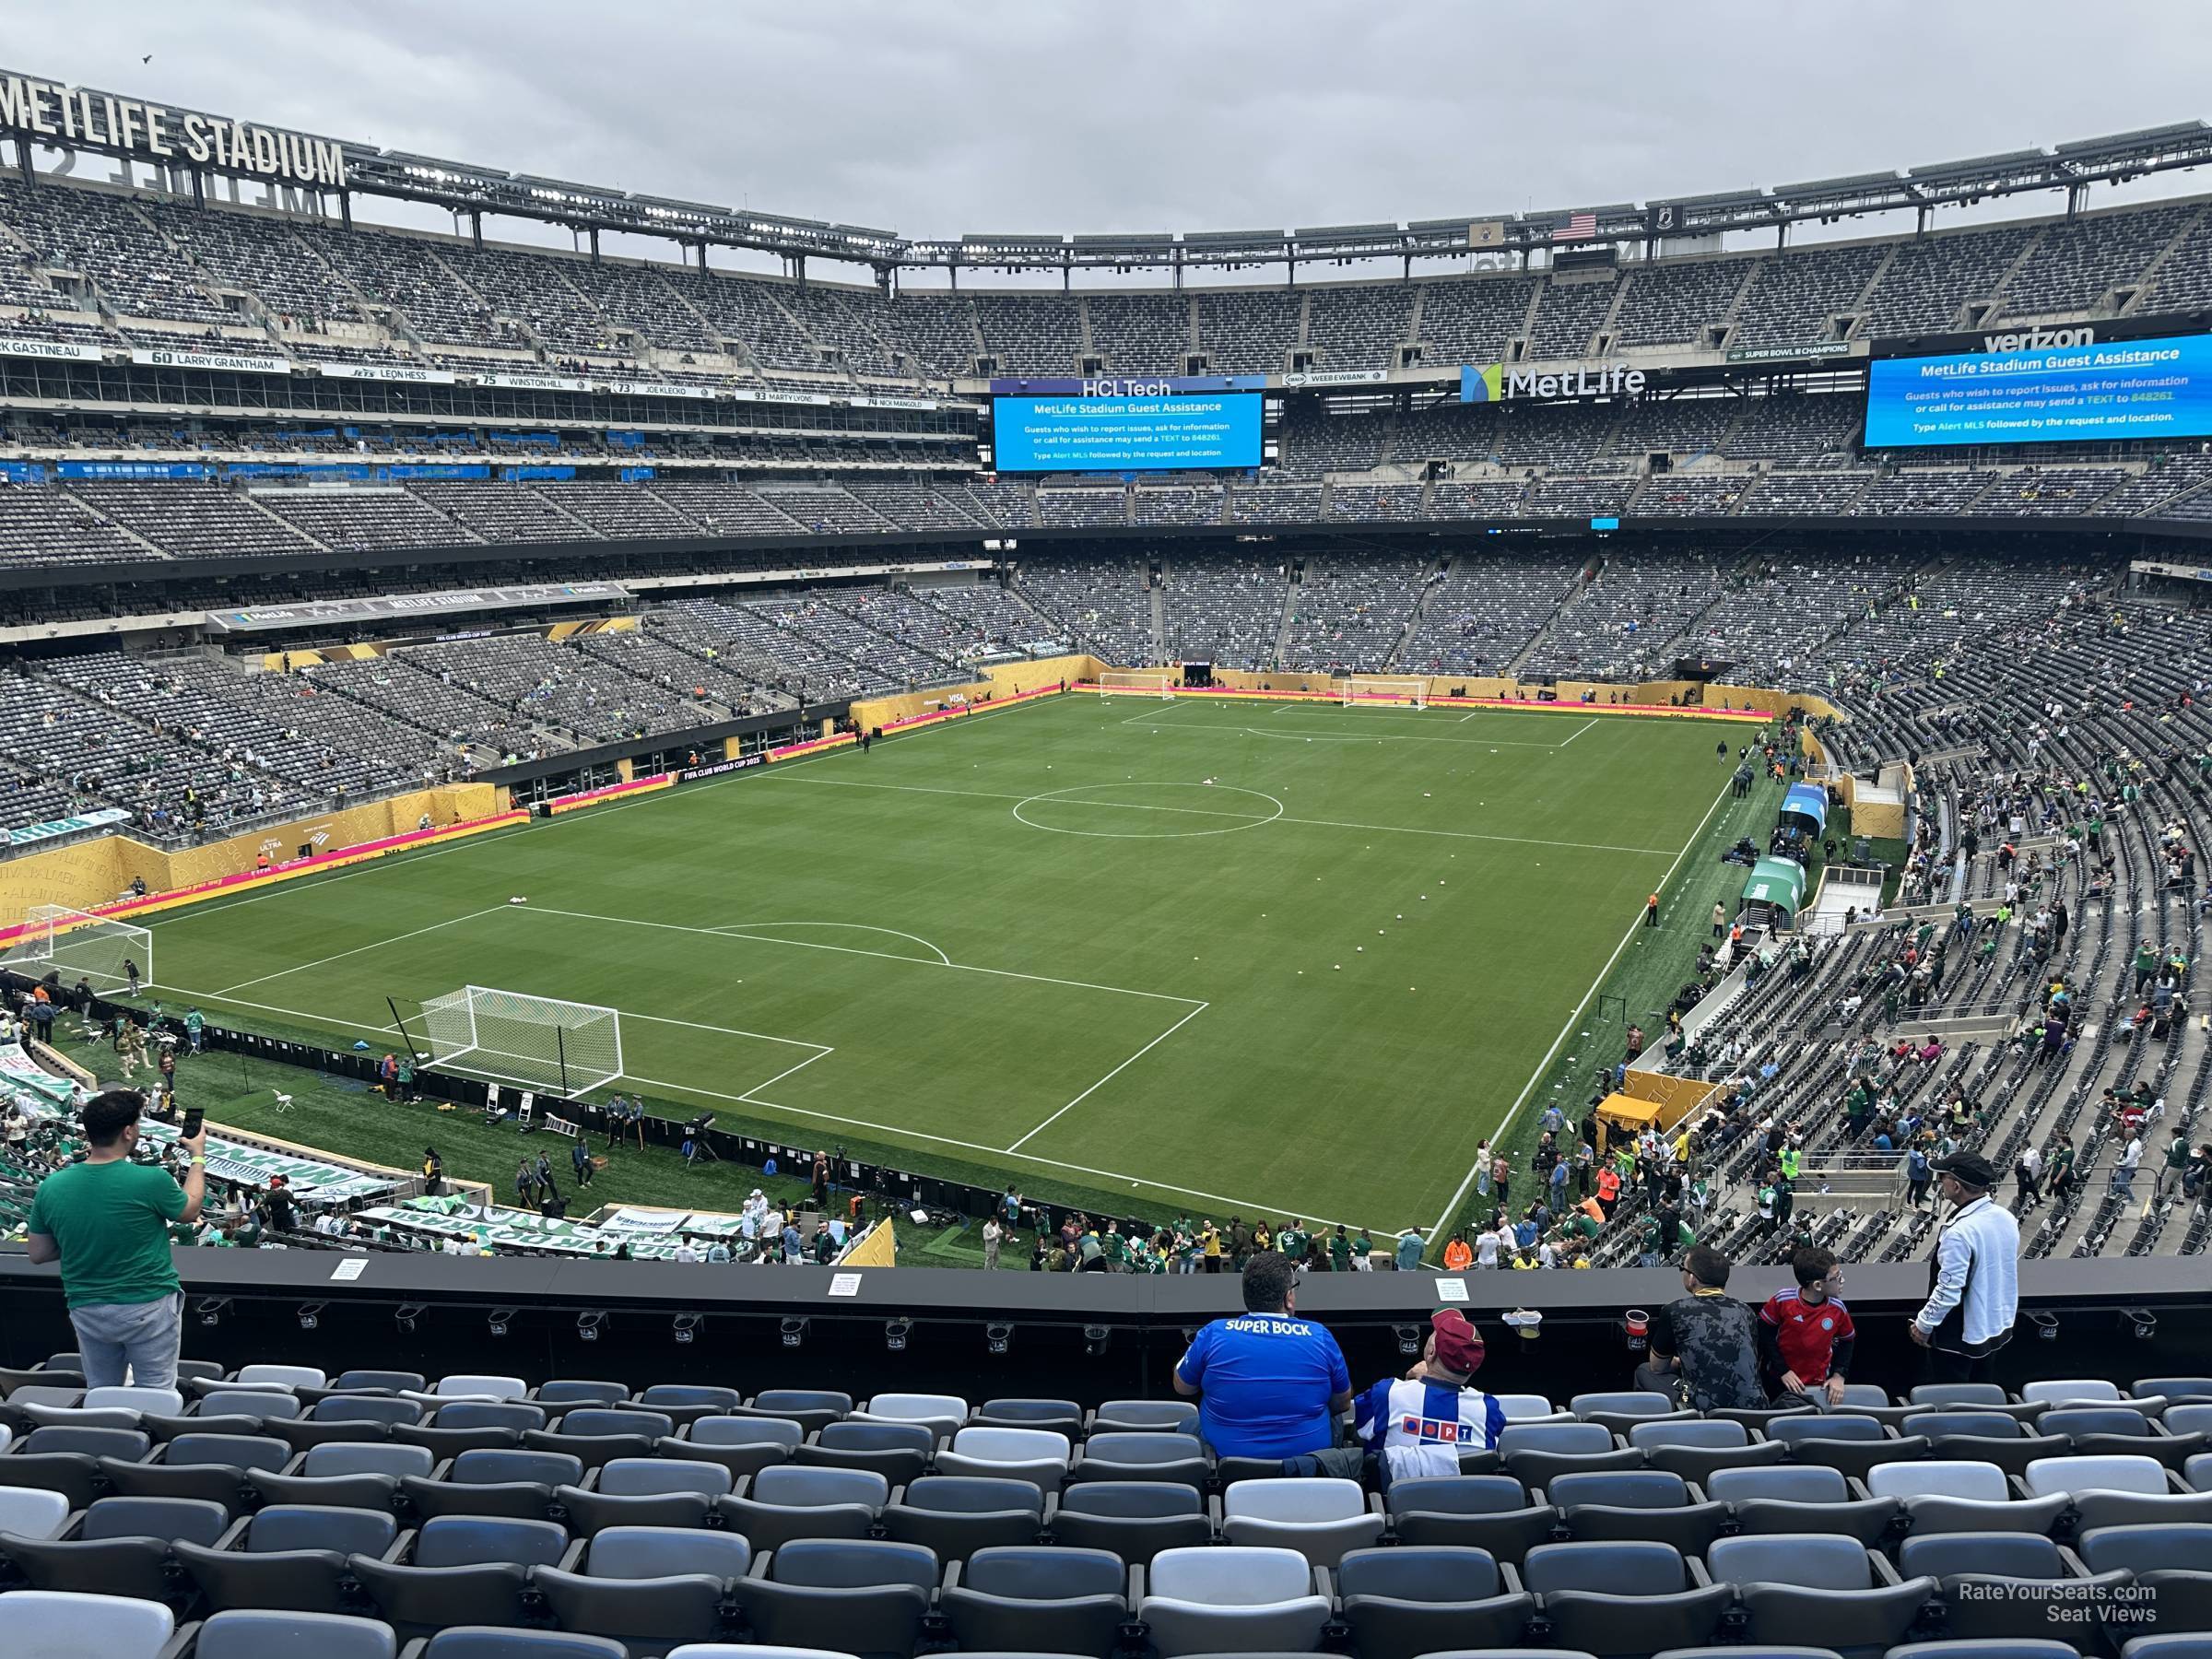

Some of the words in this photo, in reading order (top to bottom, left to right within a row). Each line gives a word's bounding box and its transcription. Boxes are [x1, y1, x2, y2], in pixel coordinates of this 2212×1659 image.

[0, 76, 173, 156] METLIFE
[183, 114, 346, 186] STADIUM
[1984, 327, 2094, 354] verizon
[12, 342, 81, 358] GASTINEAU
[1745, 350, 1769, 359] SUPER
[1802, 345, 1848, 355] CHAMPIONS
[177, 355, 212, 367] LARRY
[214, 357, 275, 371] GRANTHAM
[1921, 362, 1976, 377] MetLife
[1979, 359, 2042, 372] Stadium
[2045, 354, 2091, 368] Guest
[2094, 348, 2181, 365] Assistance
[380, 369, 403, 380] LEON
[405, 371, 427, 381] HESS
[482, 374, 496, 385] 75
[509, 376, 548, 388] WINSTON
[548, 378, 563, 388] HILL
[1507, 362, 1646, 399] MetLife
[617, 382, 630, 394] 73
[660, 386, 687, 395] KLECKO
[1083, 379, 1171, 398] HCLTech
[1905, 391, 1940, 402] Guests
[1943, 389, 1964, 398] who
[1966, 388, 1990, 397] wish
[1992, 387, 2004, 395] to
[2006, 385, 2039, 396] report
[2041, 382, 2078, 394] issues,
[2080, 382, 2100, 391] ask
[2101, 381, 2119, 390] for
[2121, 376, 2188, 388] information
[754, 392, 767, 401] 93
[866, 397, 878, 406] 74
[1928, 404, 1947, 413] call
[1949, 403, 1965, 411] for
[1967, 400, 2021, 410] assistance
[2023, 400, 2046, 409] may
[2048, 396, 2075, 406] send
[2087, 394, 2115, 405] TEXT
[2116, 394, 2129, 403] to
[1034, 404, 1077, 414] MetLife
[1079, 404, 1125, 414] Stadium
[1127, 403, 1160, 413] Guest
[1162, 402, 1222, 412] Assistance
[1053, 425, 1069, 433] who
[1071, 425, 1089, 433] wish
[1100, 425, 1125, 434] report
[1170, 423, 1182, 431] for
[1182, 423, 1230, 431] information
[1913, 423, 1936, 433] Type
[1937, 422, 1961, 430] Alert
[1964, 421, 1984, 429] MLS
[1986, 419, 2030, 429] followed
[2030, 418, 2044, 429] by
[2045, 418, 2064, 426] the
[2065, 417, 2104, 427] request
[2107, 415, 2126, 423] and
[2128, 413, 2174, 422] location.
[1114, 436, 1132, 444] may
[1161, 434, 1180, 442] TEXT
[1033, 452, 1051, 460] Type
[1088, 451, 1121, 459] followed
[1122, 451, 1132, 459] by
[1133, 450, 1147, 458] the
[1147, 451, 1174, 459] request
[390, 597, 437, 609] METLIFE
[439, 594, 484, 606] STADIUM
[251, 610, 295, 621] MetLife
[947, 692, 964, 703] VISA
[684, 771, 698, 782] FIFA
[698, 768, 713, 778] CLUB
[713, 764, 735, 774] WORLD
[734, 761, 747, 771] CUP
[747, 759, 760, 768] 2025
[259, 840, 283, 852] ULTRA
[1225, 1320, 1269, 1334] SUPER
[1273, 1321, 1312, 1336] BOCK
